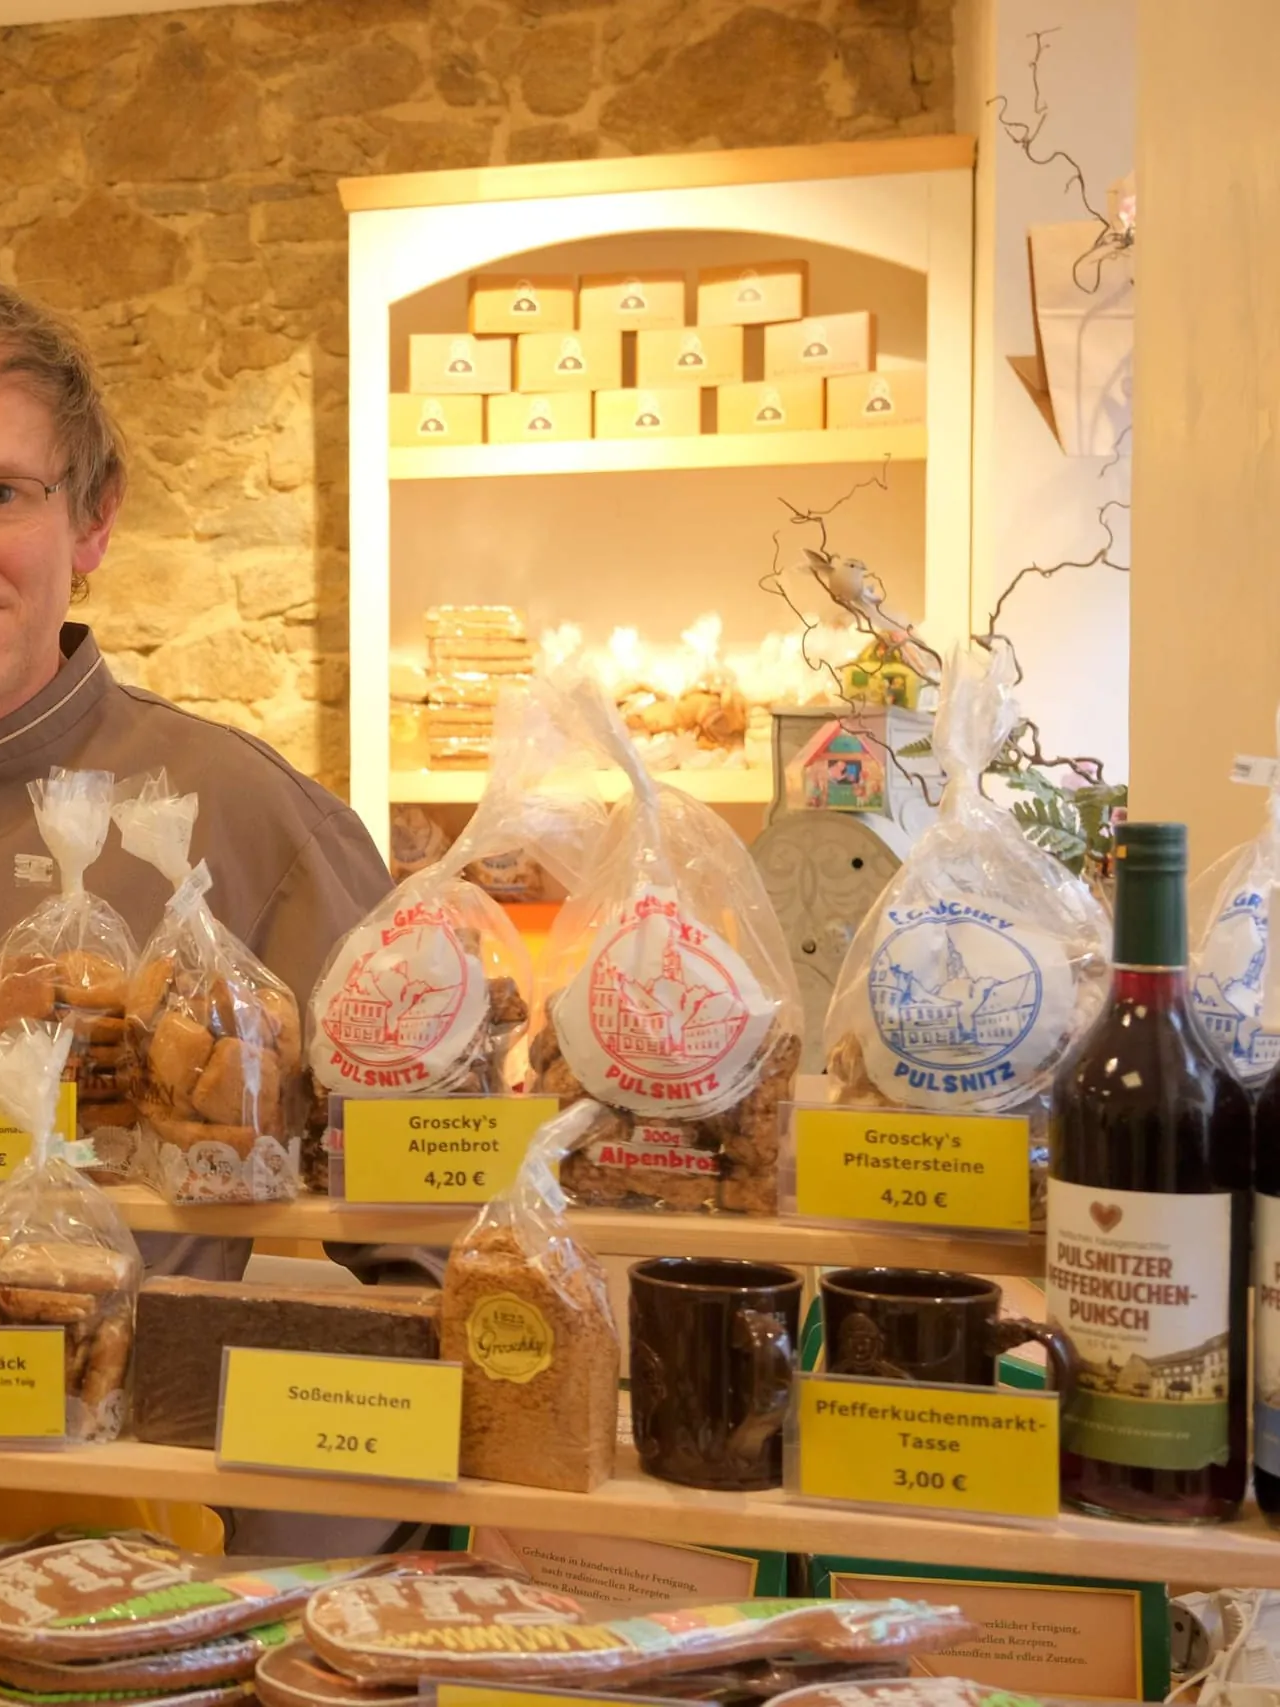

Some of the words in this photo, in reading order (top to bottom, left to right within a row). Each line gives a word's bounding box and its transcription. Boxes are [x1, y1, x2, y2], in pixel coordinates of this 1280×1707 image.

[329, 1051, 430, 1088] PULSNITZ
[605, 1063, 720, 1100] PULSNITZ
[893, 1060, 1017, 1094] PULSNITZ
[408, 1139, 500, 1155] Alpenbrot
[843, 1152, 985, 1175] Pflastersteine
[424, 1171, 467, 1189] 4,20
[472, 1171, 485, 1186] €
[880, 1189, 928, 1208] 4,20
[934, 1191, 948, 1208] €
[1057, 1241, 1173, 1279] PULSNITZER
[1069, 1298, 1150, 1332] PUNSCH
[0, 1377, 13, 1386] im
[288, 1385, 412, 1410] Soßenkuchen
[816, 1399, 1046, 1433] Pfefferkuchenmarkt-
[316, 1433, 359, 1452] 2,20
[365, 1438, 378, 1454] €
[898, 1432, 961, 1452] Tasse
[893, 1468, 945, 1490] 3,00
[952, 1473, 968, 1492] €
[522, 1546, 567, 1564] Gebacken
[580, 1558, 650, 1582] handwerklicher
[541, 1567, 563, 1578] nach
[565, 1571, 626, 1591] traditionellen
[561, 1583, 611, 1601] Rohstoffen
[994, 1650, 1014, 1661] und
[1016, 1652, 1043, 1663] edlen
[1045, 1653, 1087, 1665] Zutaten.
